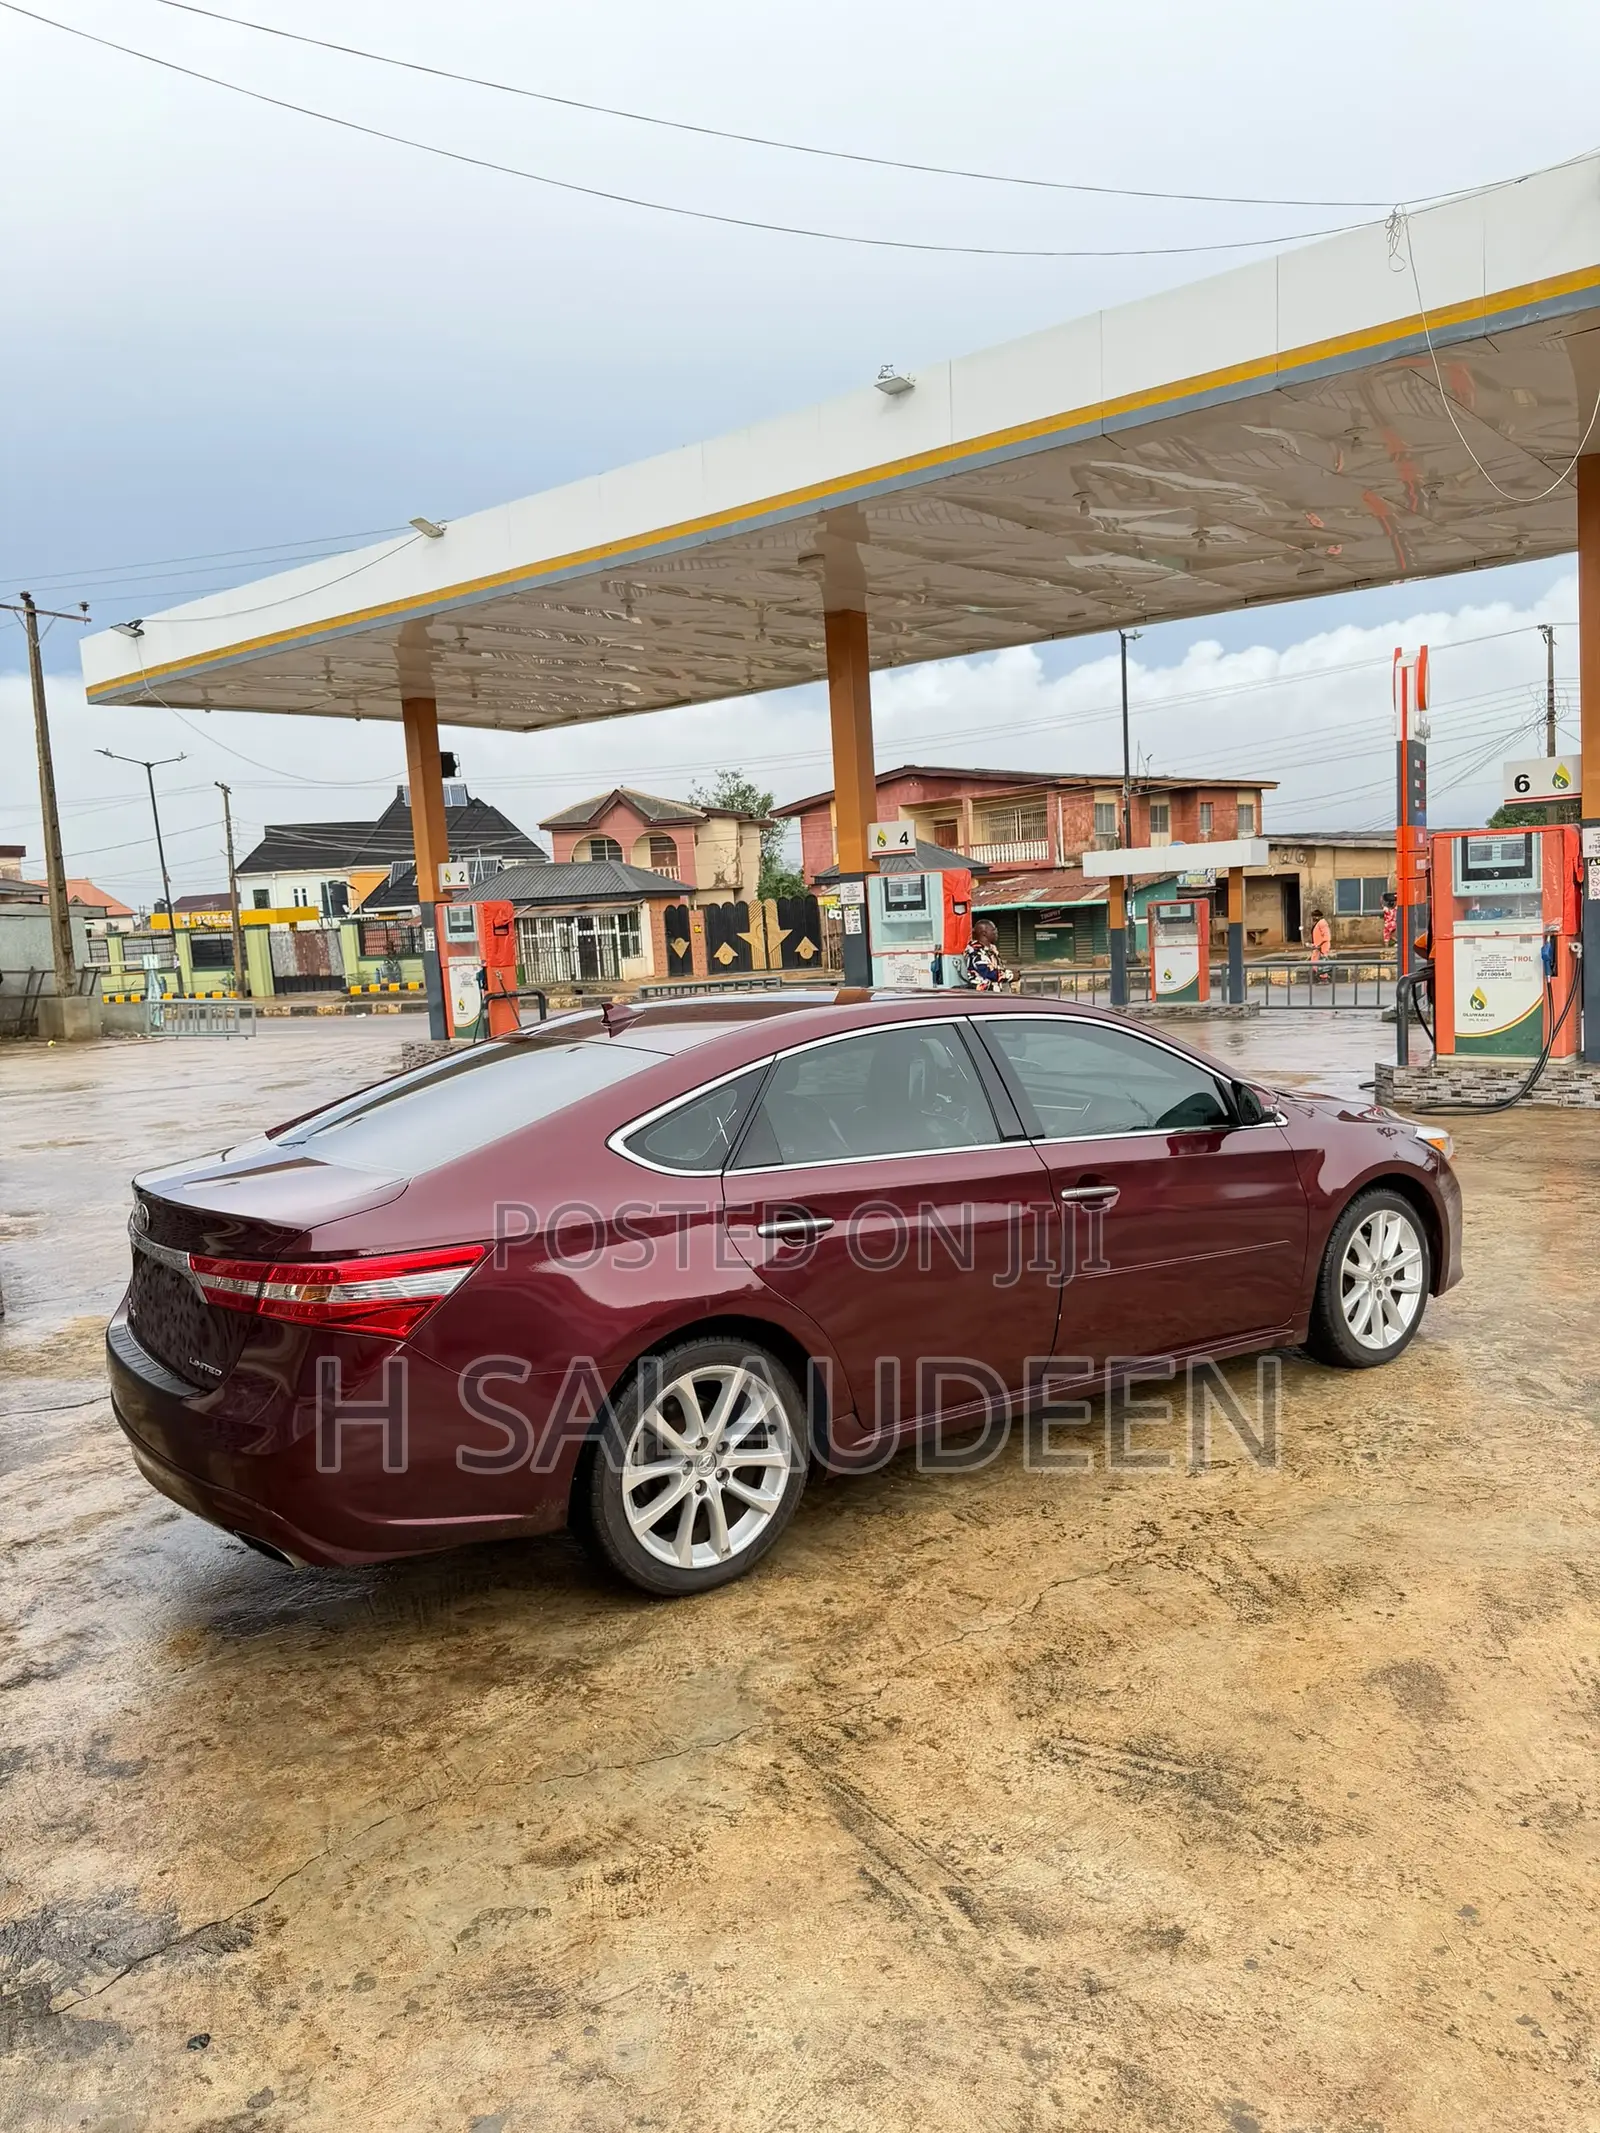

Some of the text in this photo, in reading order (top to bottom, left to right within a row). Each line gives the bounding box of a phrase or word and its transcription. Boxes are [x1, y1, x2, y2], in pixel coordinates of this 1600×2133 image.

[1514, 774, 1530, 793] 6
[899, 831, 909, 845] 4
[459, 871, 465, 882] 2
[189, 1356, 222, 1377] LIMITED
